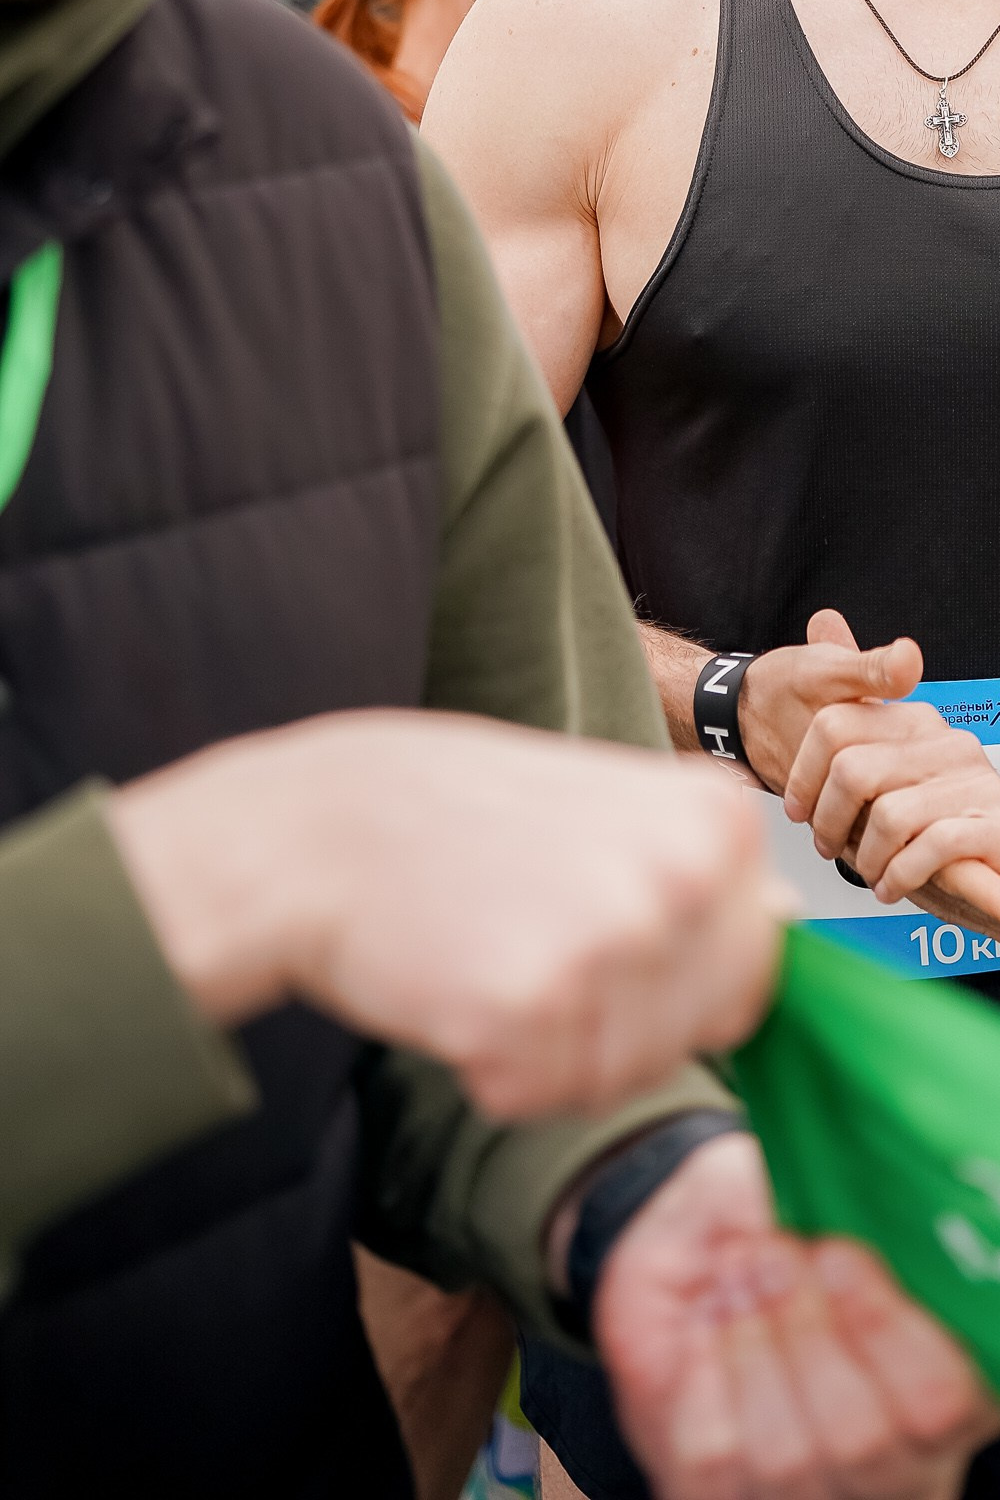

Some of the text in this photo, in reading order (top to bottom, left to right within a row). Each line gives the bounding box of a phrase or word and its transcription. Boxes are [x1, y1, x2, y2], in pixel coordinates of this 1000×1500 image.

[938, 699, 993, 714] зелёный
[941, 712, 989, 726] арафон
[909, 923, 966, 967] 10
